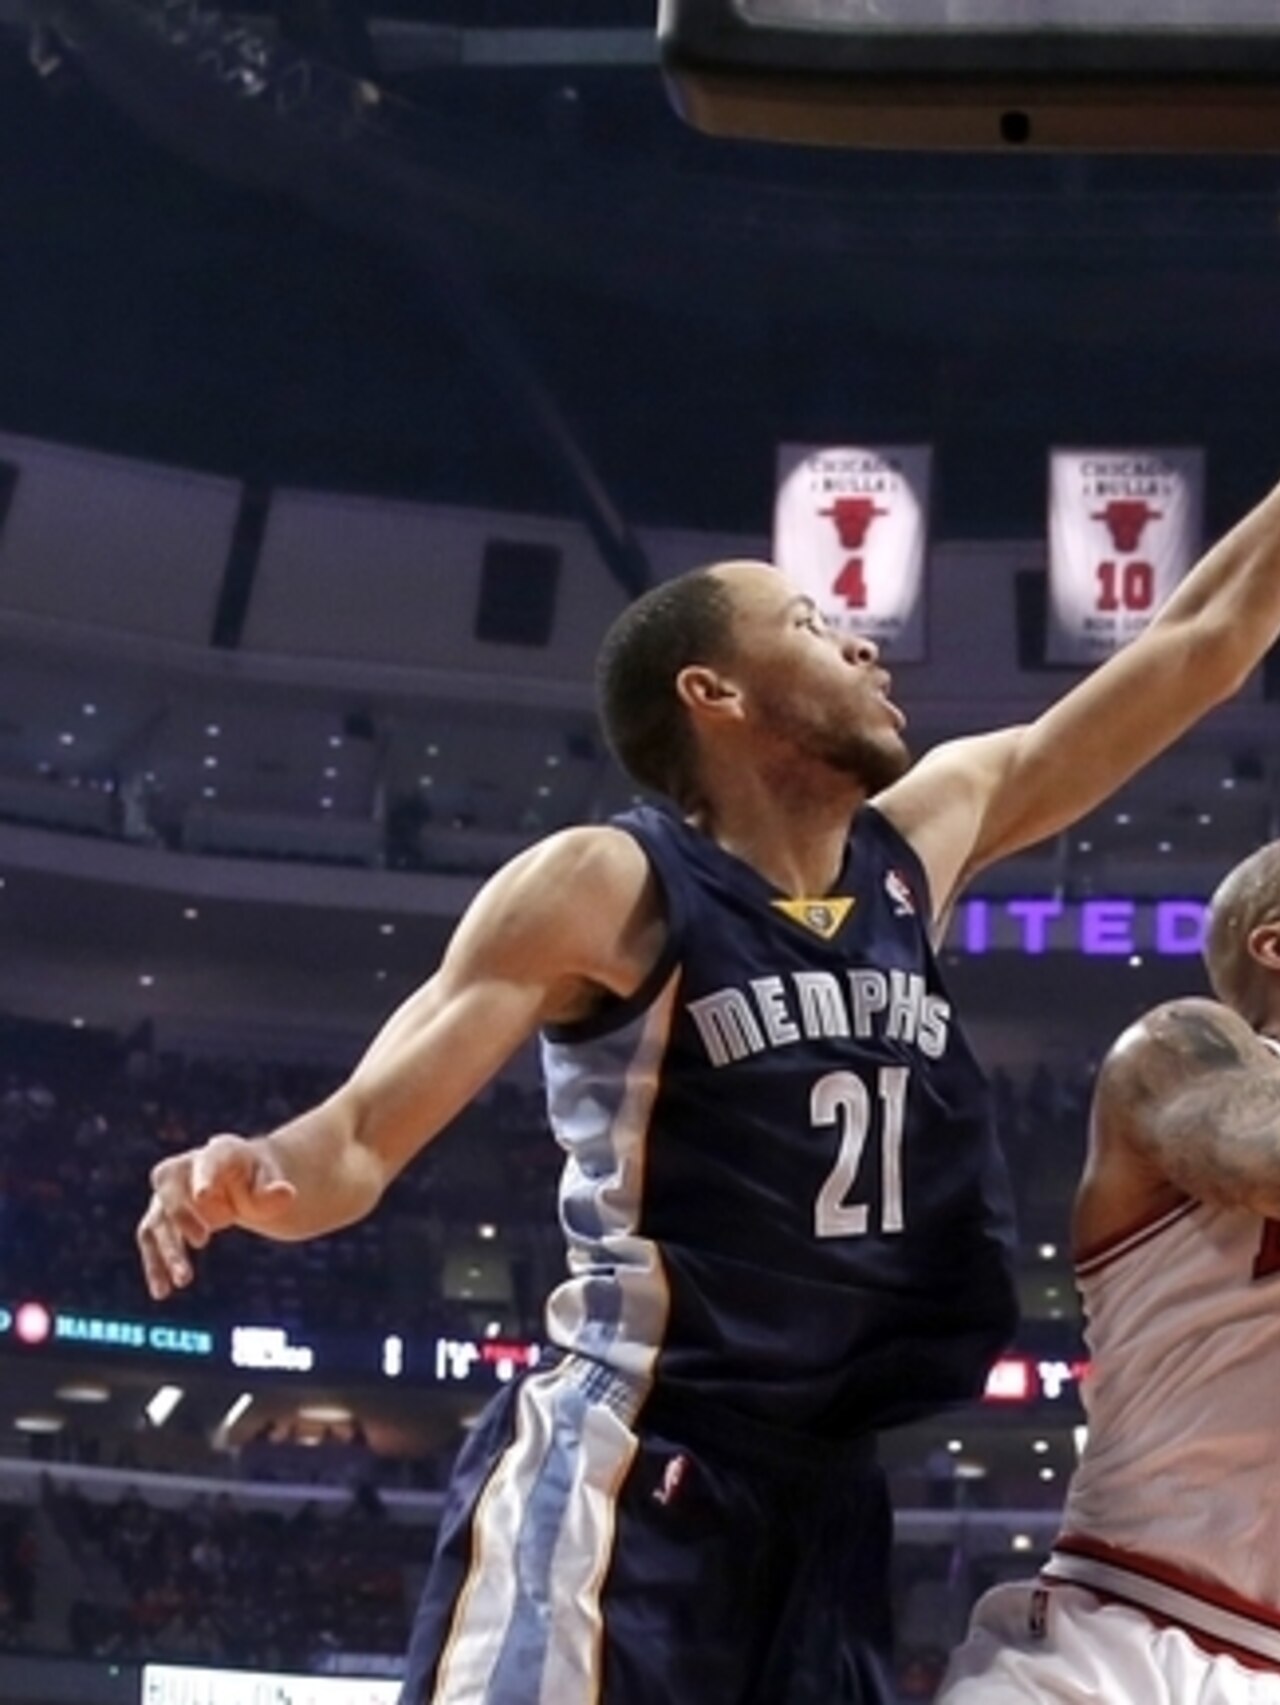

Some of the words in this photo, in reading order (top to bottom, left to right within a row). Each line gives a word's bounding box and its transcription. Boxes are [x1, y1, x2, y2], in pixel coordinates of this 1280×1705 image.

[832, 558, 867, 609] 4
[1096, 562, 1155, 612] 10
[966, 900, 1208, 953] ITED
[687, 968, 951, 1067] MEMPHS
[809, 1066, 911, 1238] 21
